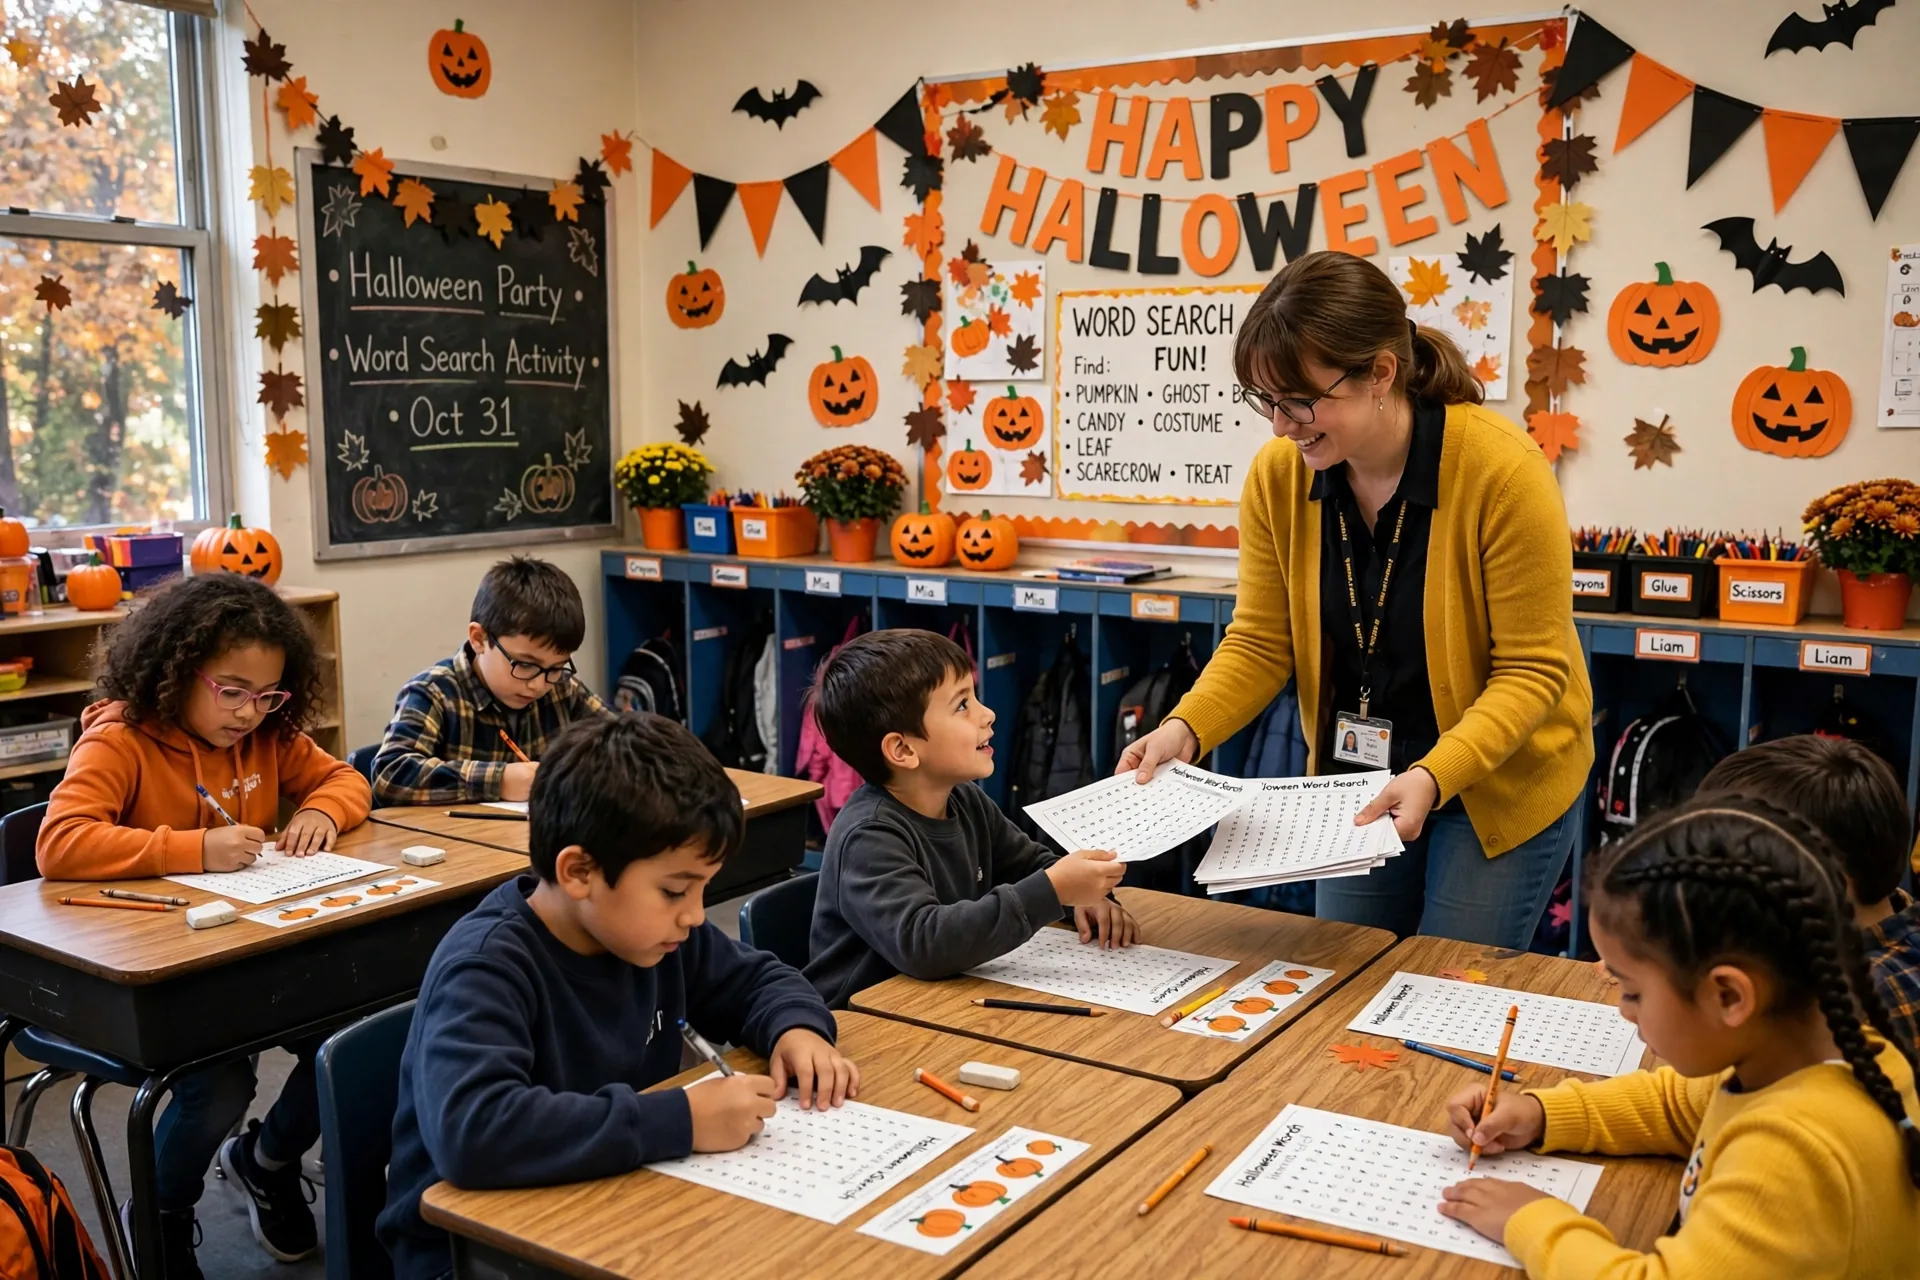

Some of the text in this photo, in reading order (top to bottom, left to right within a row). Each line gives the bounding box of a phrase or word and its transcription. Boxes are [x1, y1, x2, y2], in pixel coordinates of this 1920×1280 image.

[1086, 63, 1379, 180] HAPPY
[980, 117, 1508, 277] HALLOWEEN
[349, 251, 563, 325] Halloween Party
[1073, 303, 1233, 337] WORD SEARCH
[345, 334, 586, 390] Word Search Activity
[1074, 356, 1111, 375] Find:
[1155, 345, 1207, 372] FUN!
[1076, 383, 1138, 404] PUMPKIN
[1162, 383, 1210, 404] GHOST
[410, 395, 516, 437] Oct 31
[1077, 412, 1223, 433] CANDY COSTUME
[1078, 437, 1113, 456] LEAF
[1076, 462, 1233, 484] SCARECROW TREAT
[914, 585, 935, 598] Mia
[1572, 578, 1606, 591] ayons
[1651, 579, 1678, 593] Glue
[1732, 584, 1782, 600] Scissors
[1023, 592, 1045, 606] Mia
[1651, 634, 1684, 653] Liam
[1814, 648, 1853, 666] Liam
[1261, 778, 1369, 791] loween Word Search
